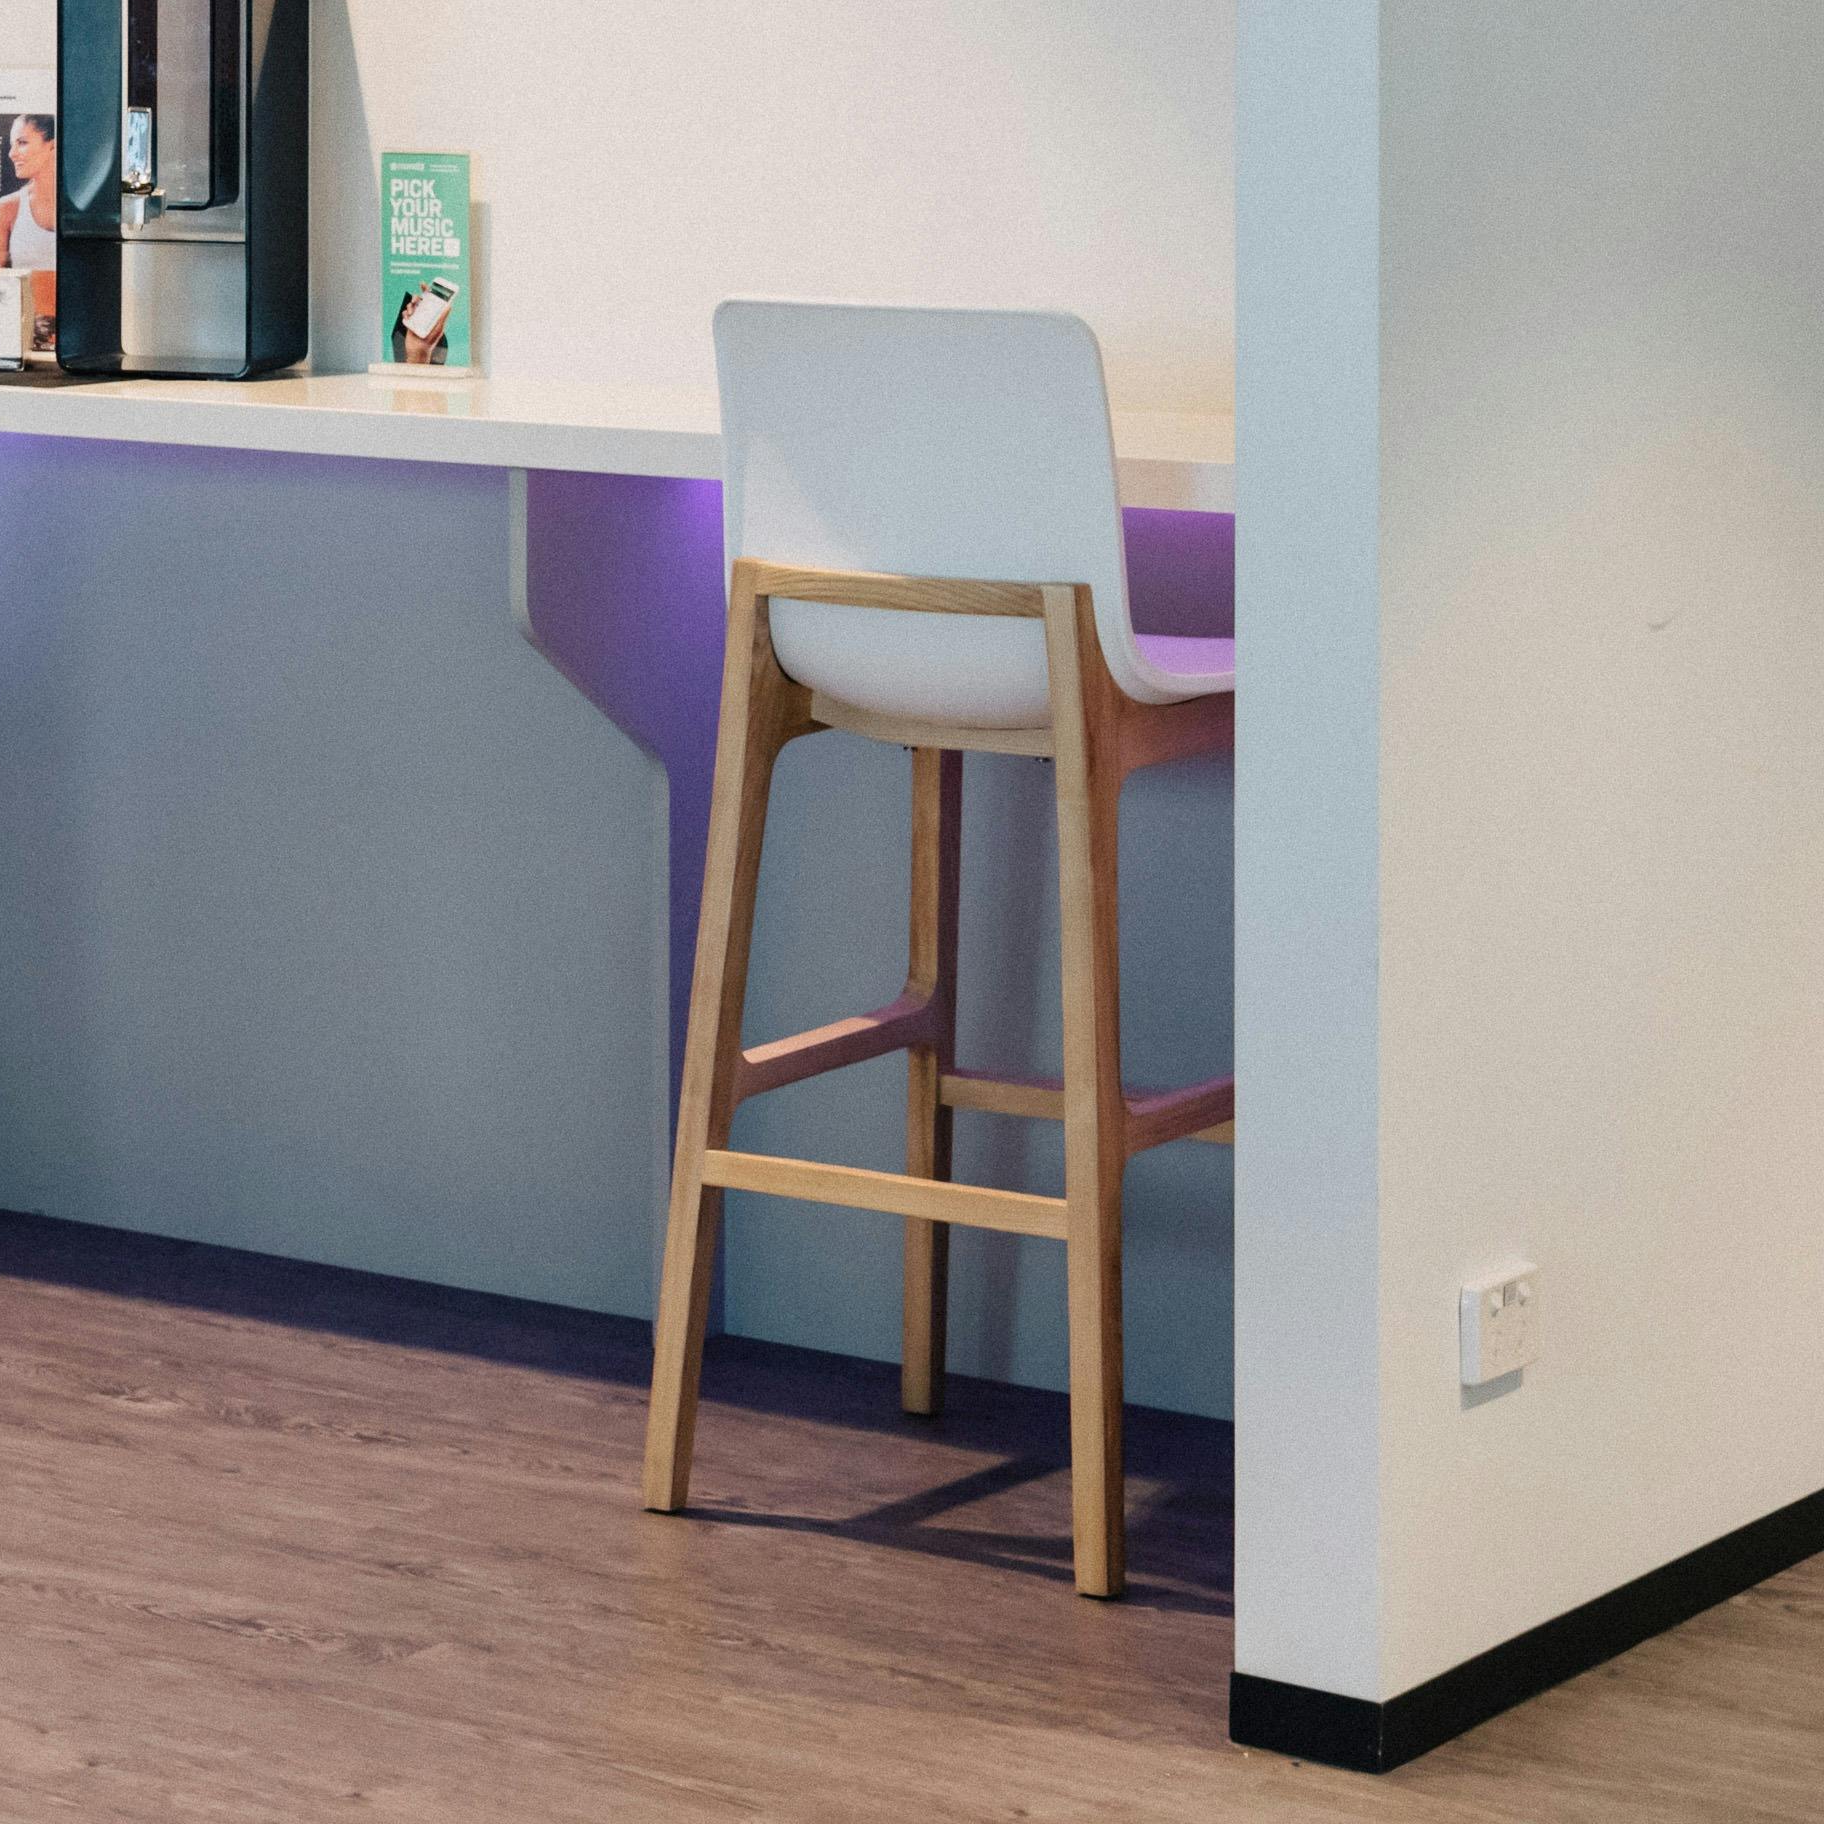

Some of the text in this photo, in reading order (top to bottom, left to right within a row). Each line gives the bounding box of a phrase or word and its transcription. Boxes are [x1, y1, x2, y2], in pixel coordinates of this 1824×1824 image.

[390, 179, 436, 198] PICK
[390, 198, 443, 217] YOUR
[391, 217, 454, 236] MUSIC
[391, 236, 443, 256] HERE
